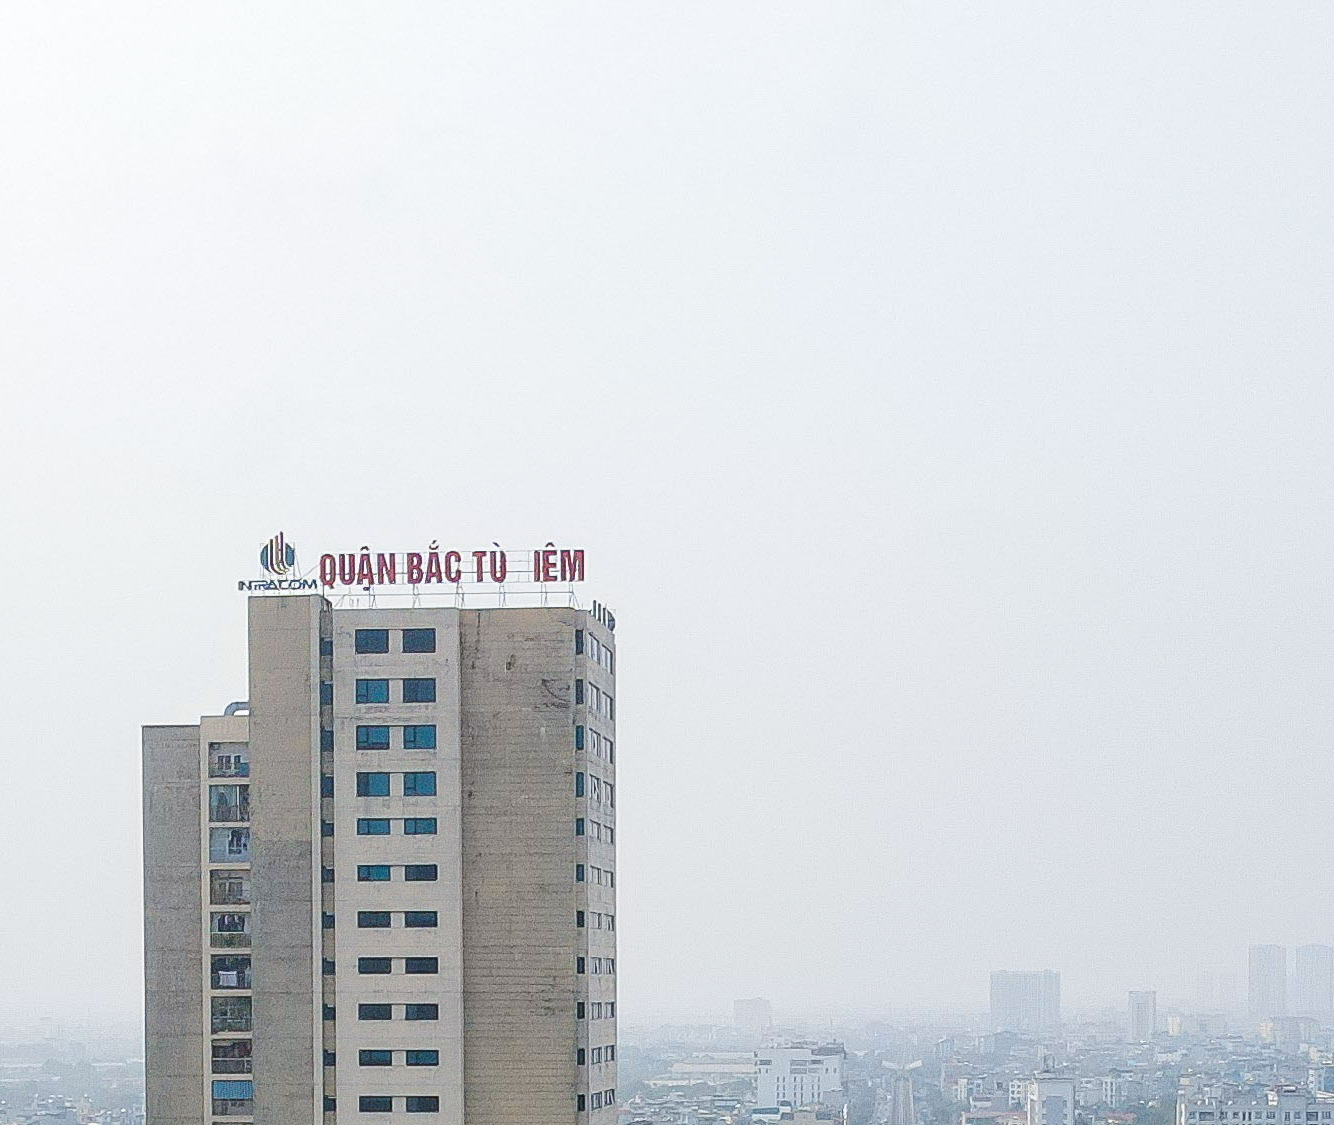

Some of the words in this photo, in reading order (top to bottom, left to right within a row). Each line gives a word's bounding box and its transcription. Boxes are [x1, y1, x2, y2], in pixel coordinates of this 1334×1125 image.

[319, 545, 396, 591] QUẬN
[407, 540, 461, 584] BẮC
[238, 579, 318, 591] INTRACOM
